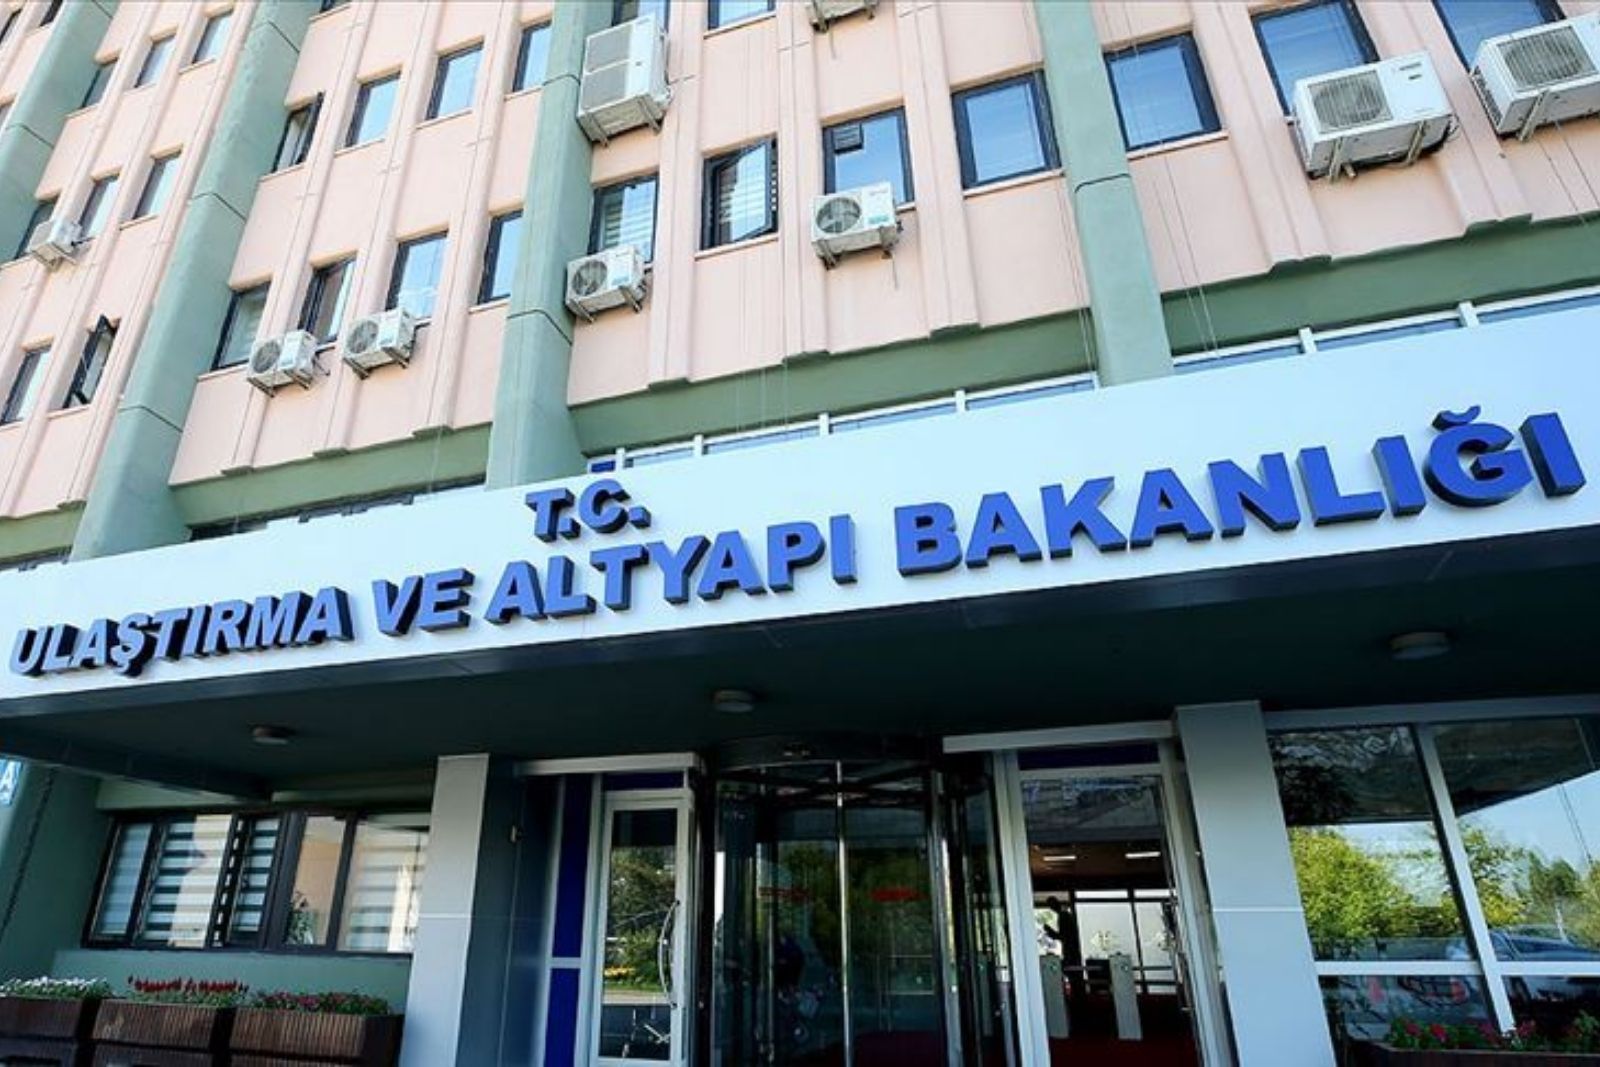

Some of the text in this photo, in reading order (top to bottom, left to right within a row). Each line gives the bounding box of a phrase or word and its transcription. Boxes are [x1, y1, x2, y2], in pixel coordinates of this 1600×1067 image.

[10, 405, 1587, 676] ULAŞTIRMA VE ALTYAPI BAKANLIĞI
[527, 479, 651, 541] T.C.
